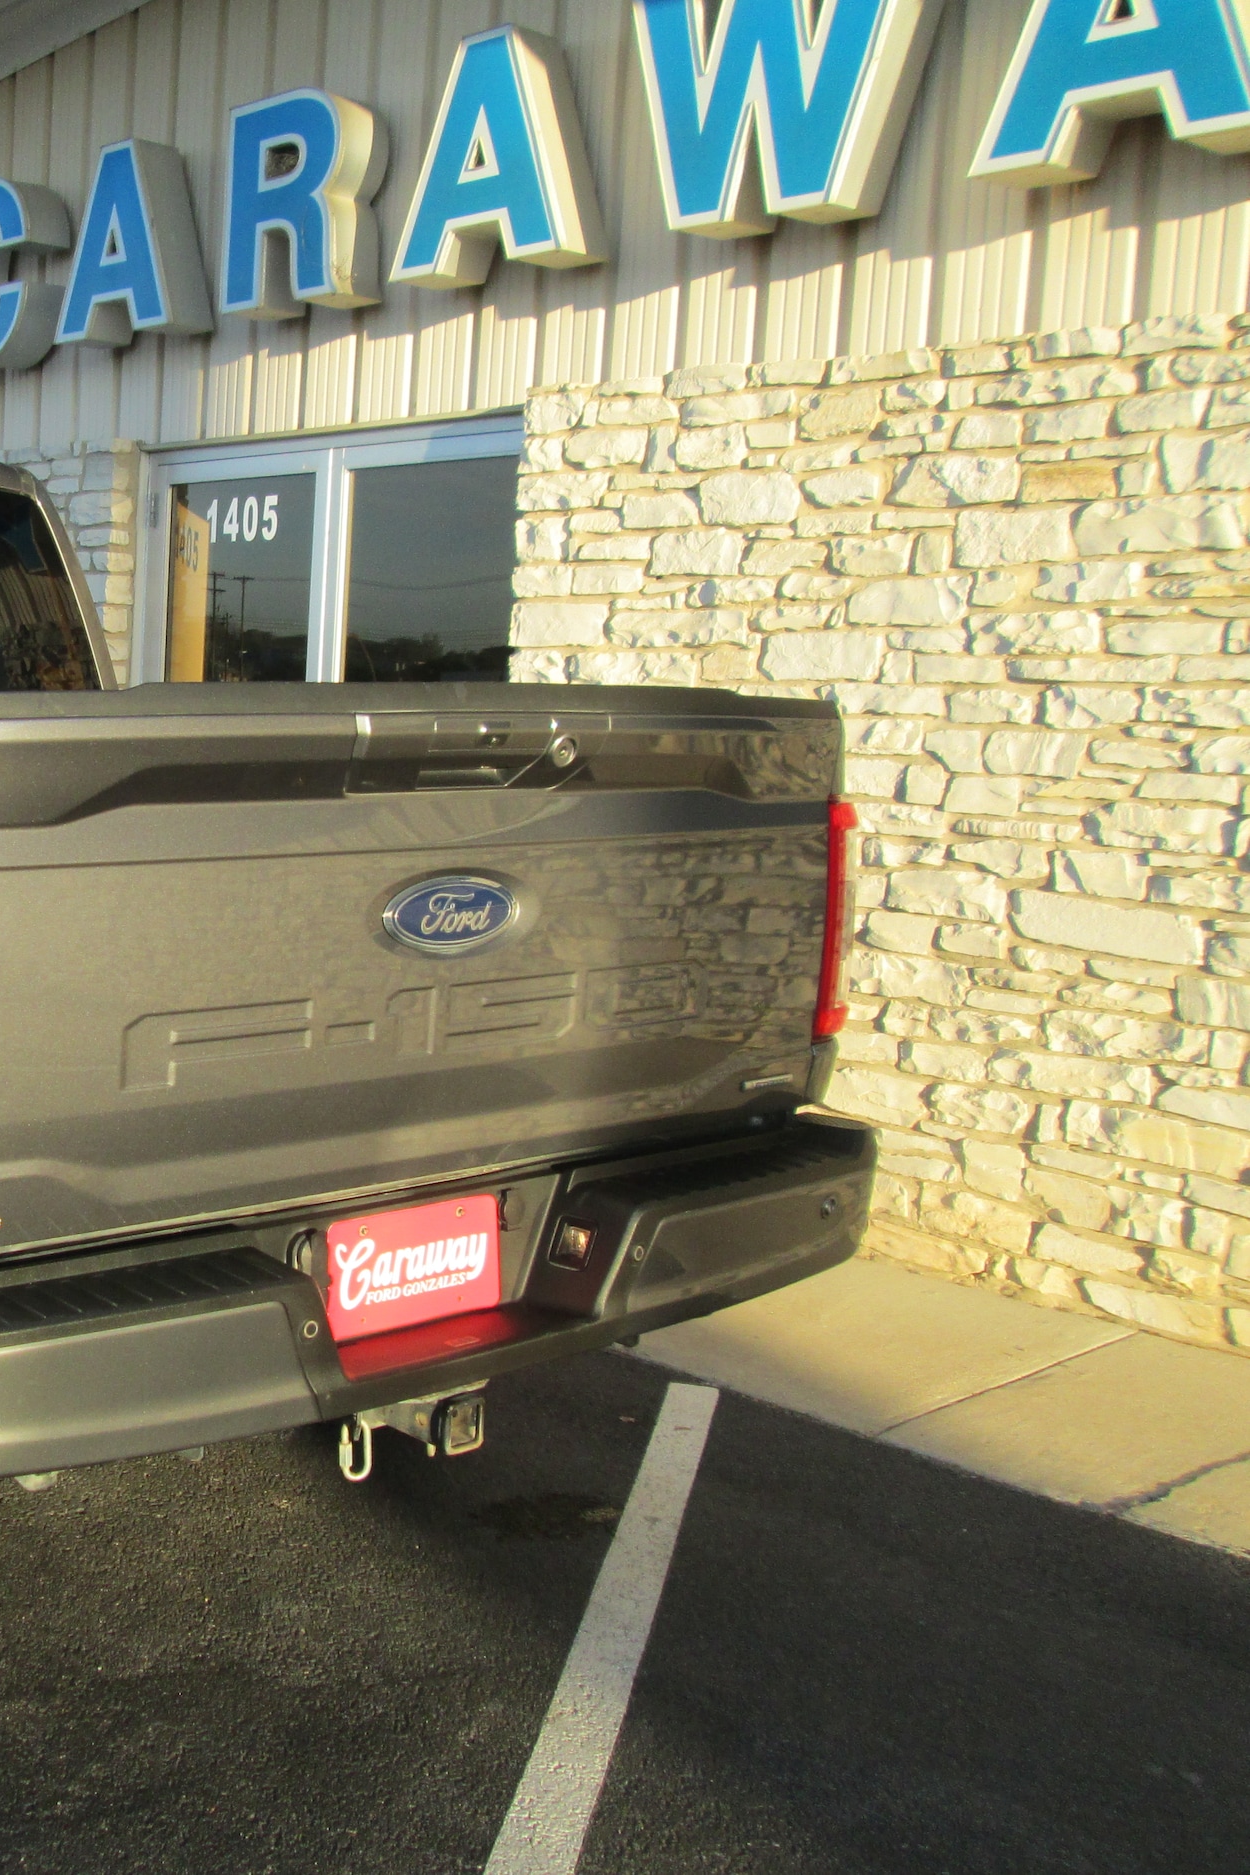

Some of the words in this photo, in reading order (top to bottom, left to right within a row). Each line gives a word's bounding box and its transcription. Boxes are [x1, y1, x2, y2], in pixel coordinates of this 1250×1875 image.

[207, 494, 279, 544] 1405
[420, 892, 492, 935] Ford
[120, 959, 707, 1091] F-150
[334, 1232, 488, 1311] Caraway
[364, 1285, 401, 1306] FORD
[402, 1271, 467, 1298] GONZALES
